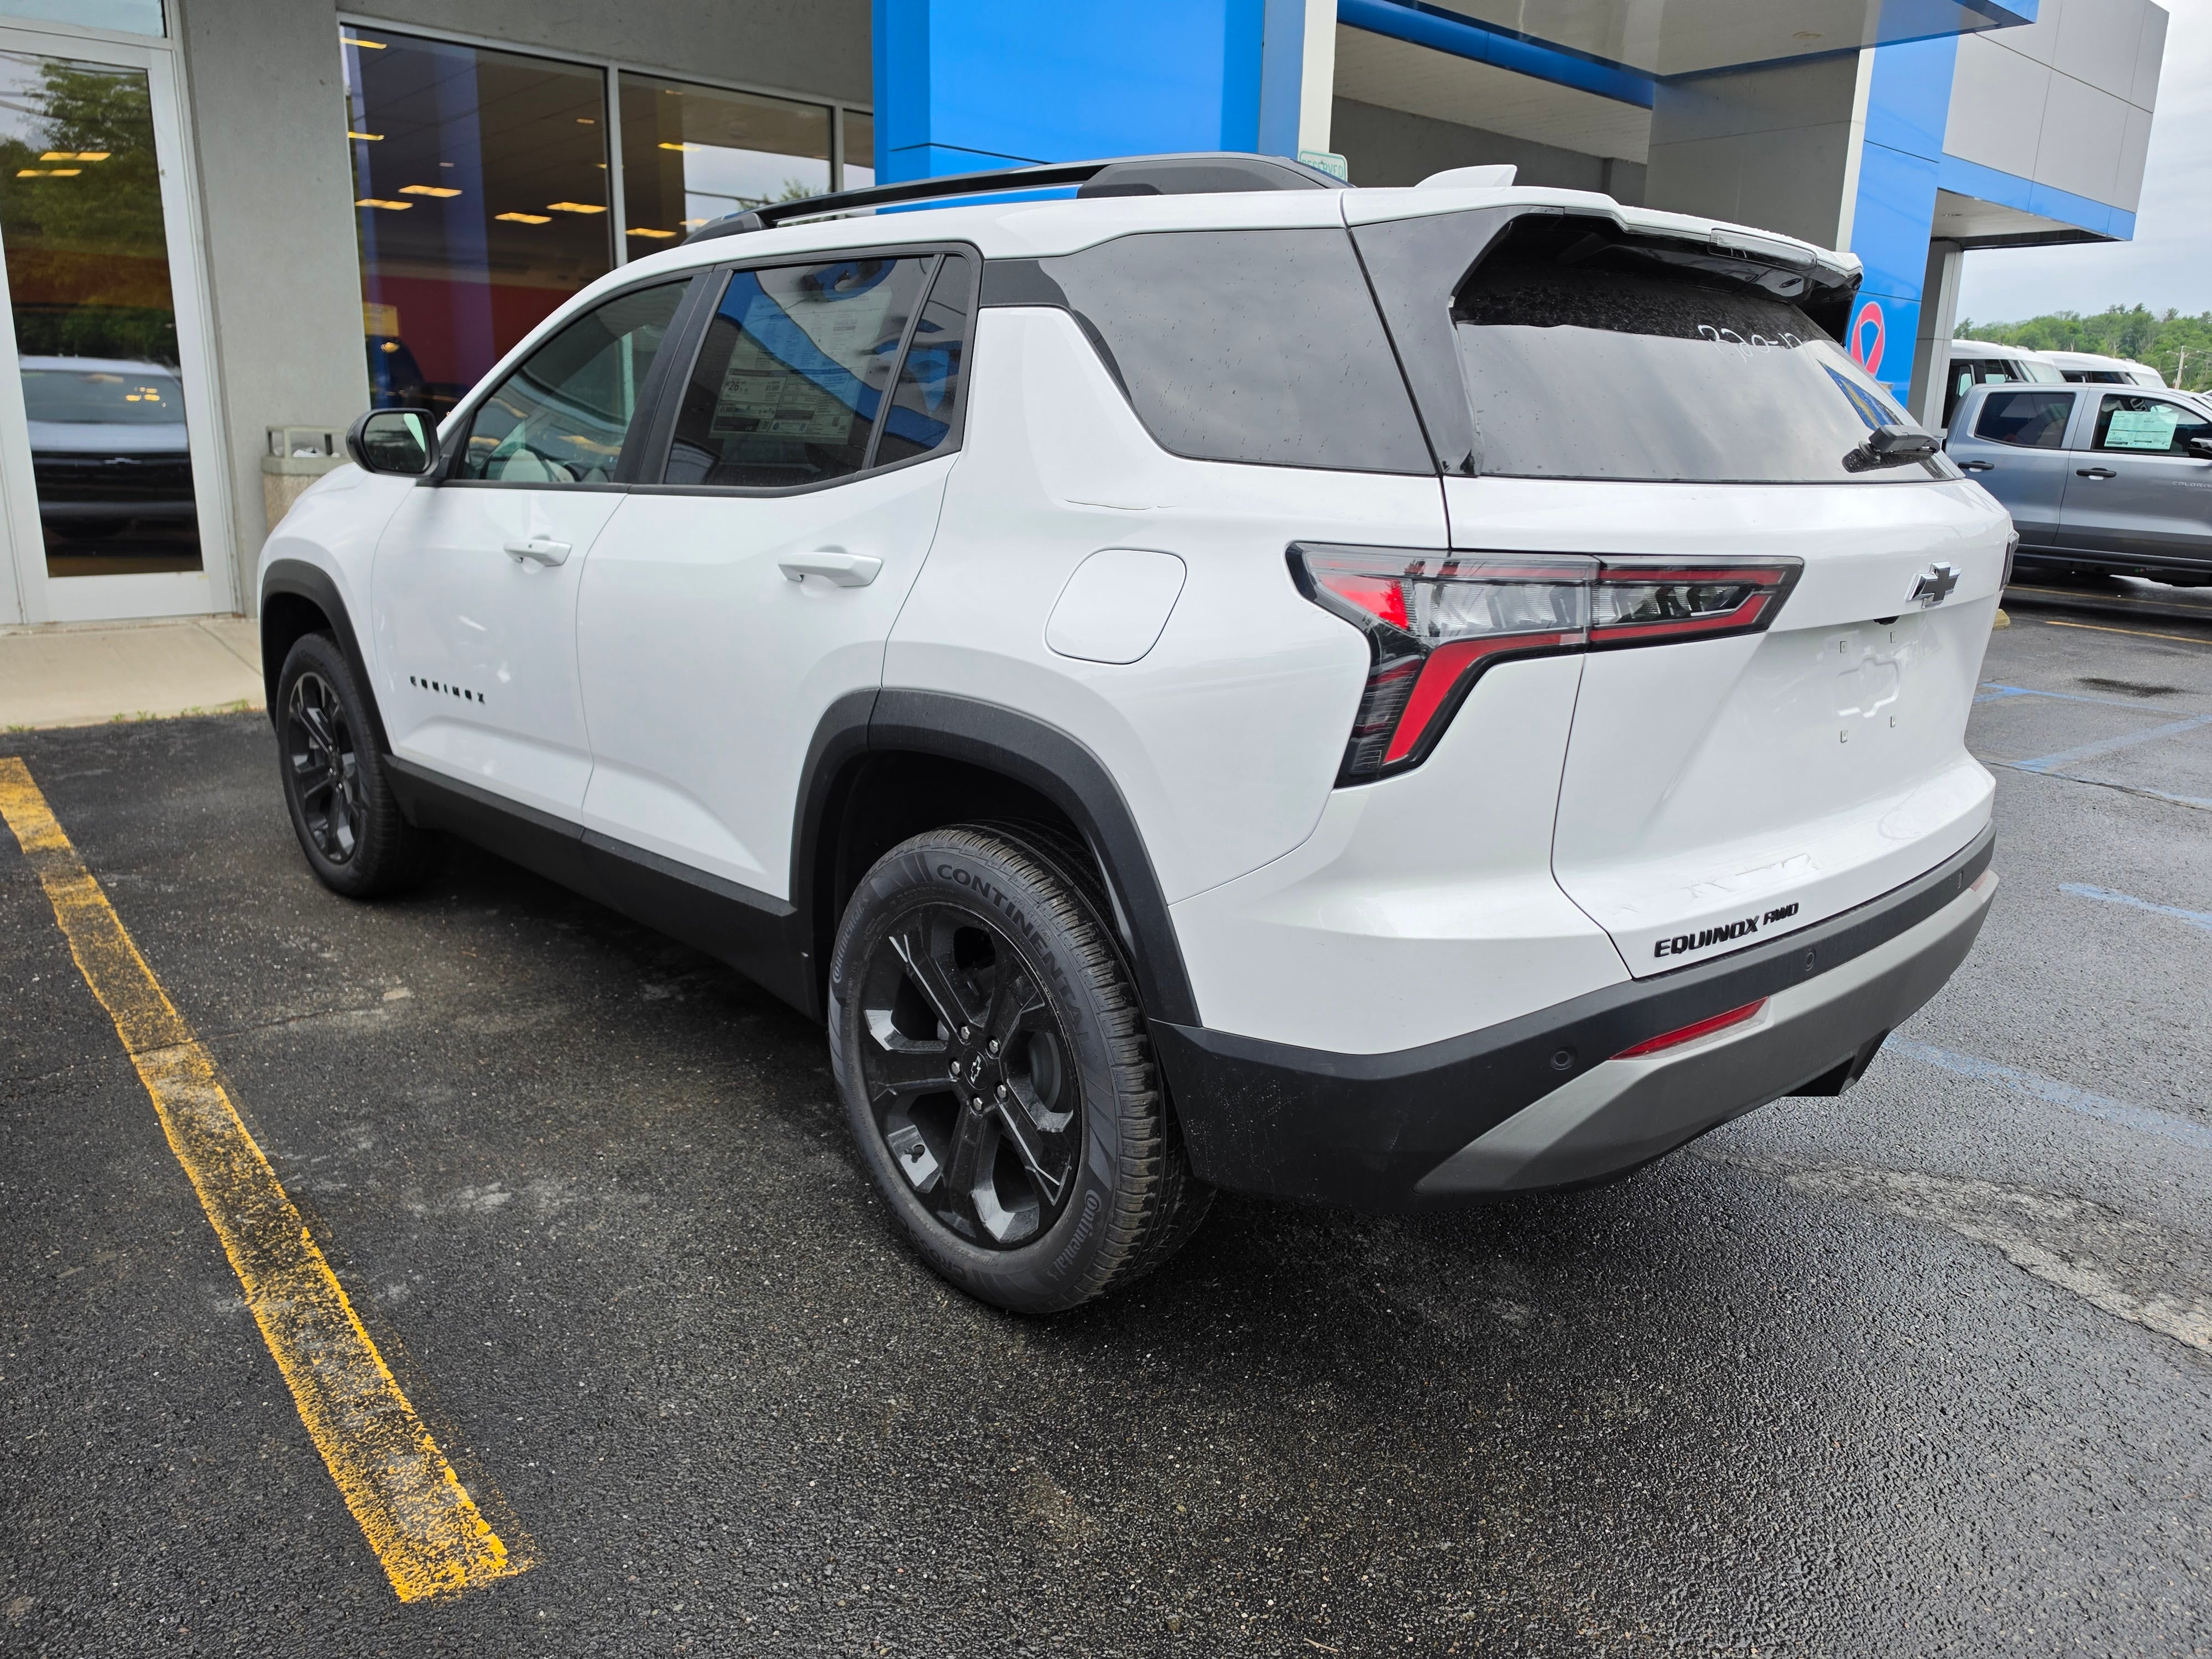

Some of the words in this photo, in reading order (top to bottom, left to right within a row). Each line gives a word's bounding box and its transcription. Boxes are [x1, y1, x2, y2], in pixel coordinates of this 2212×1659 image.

[410, 676, 485, 704] EQUINOX
[937, 864, 1091, 1057] CONTINENTAL
[1654, 915, 1759, 957] EQUINOX
[1763, 902, 1799, 925] AWD
[1053, 1190, 1102, 1275] Continental
